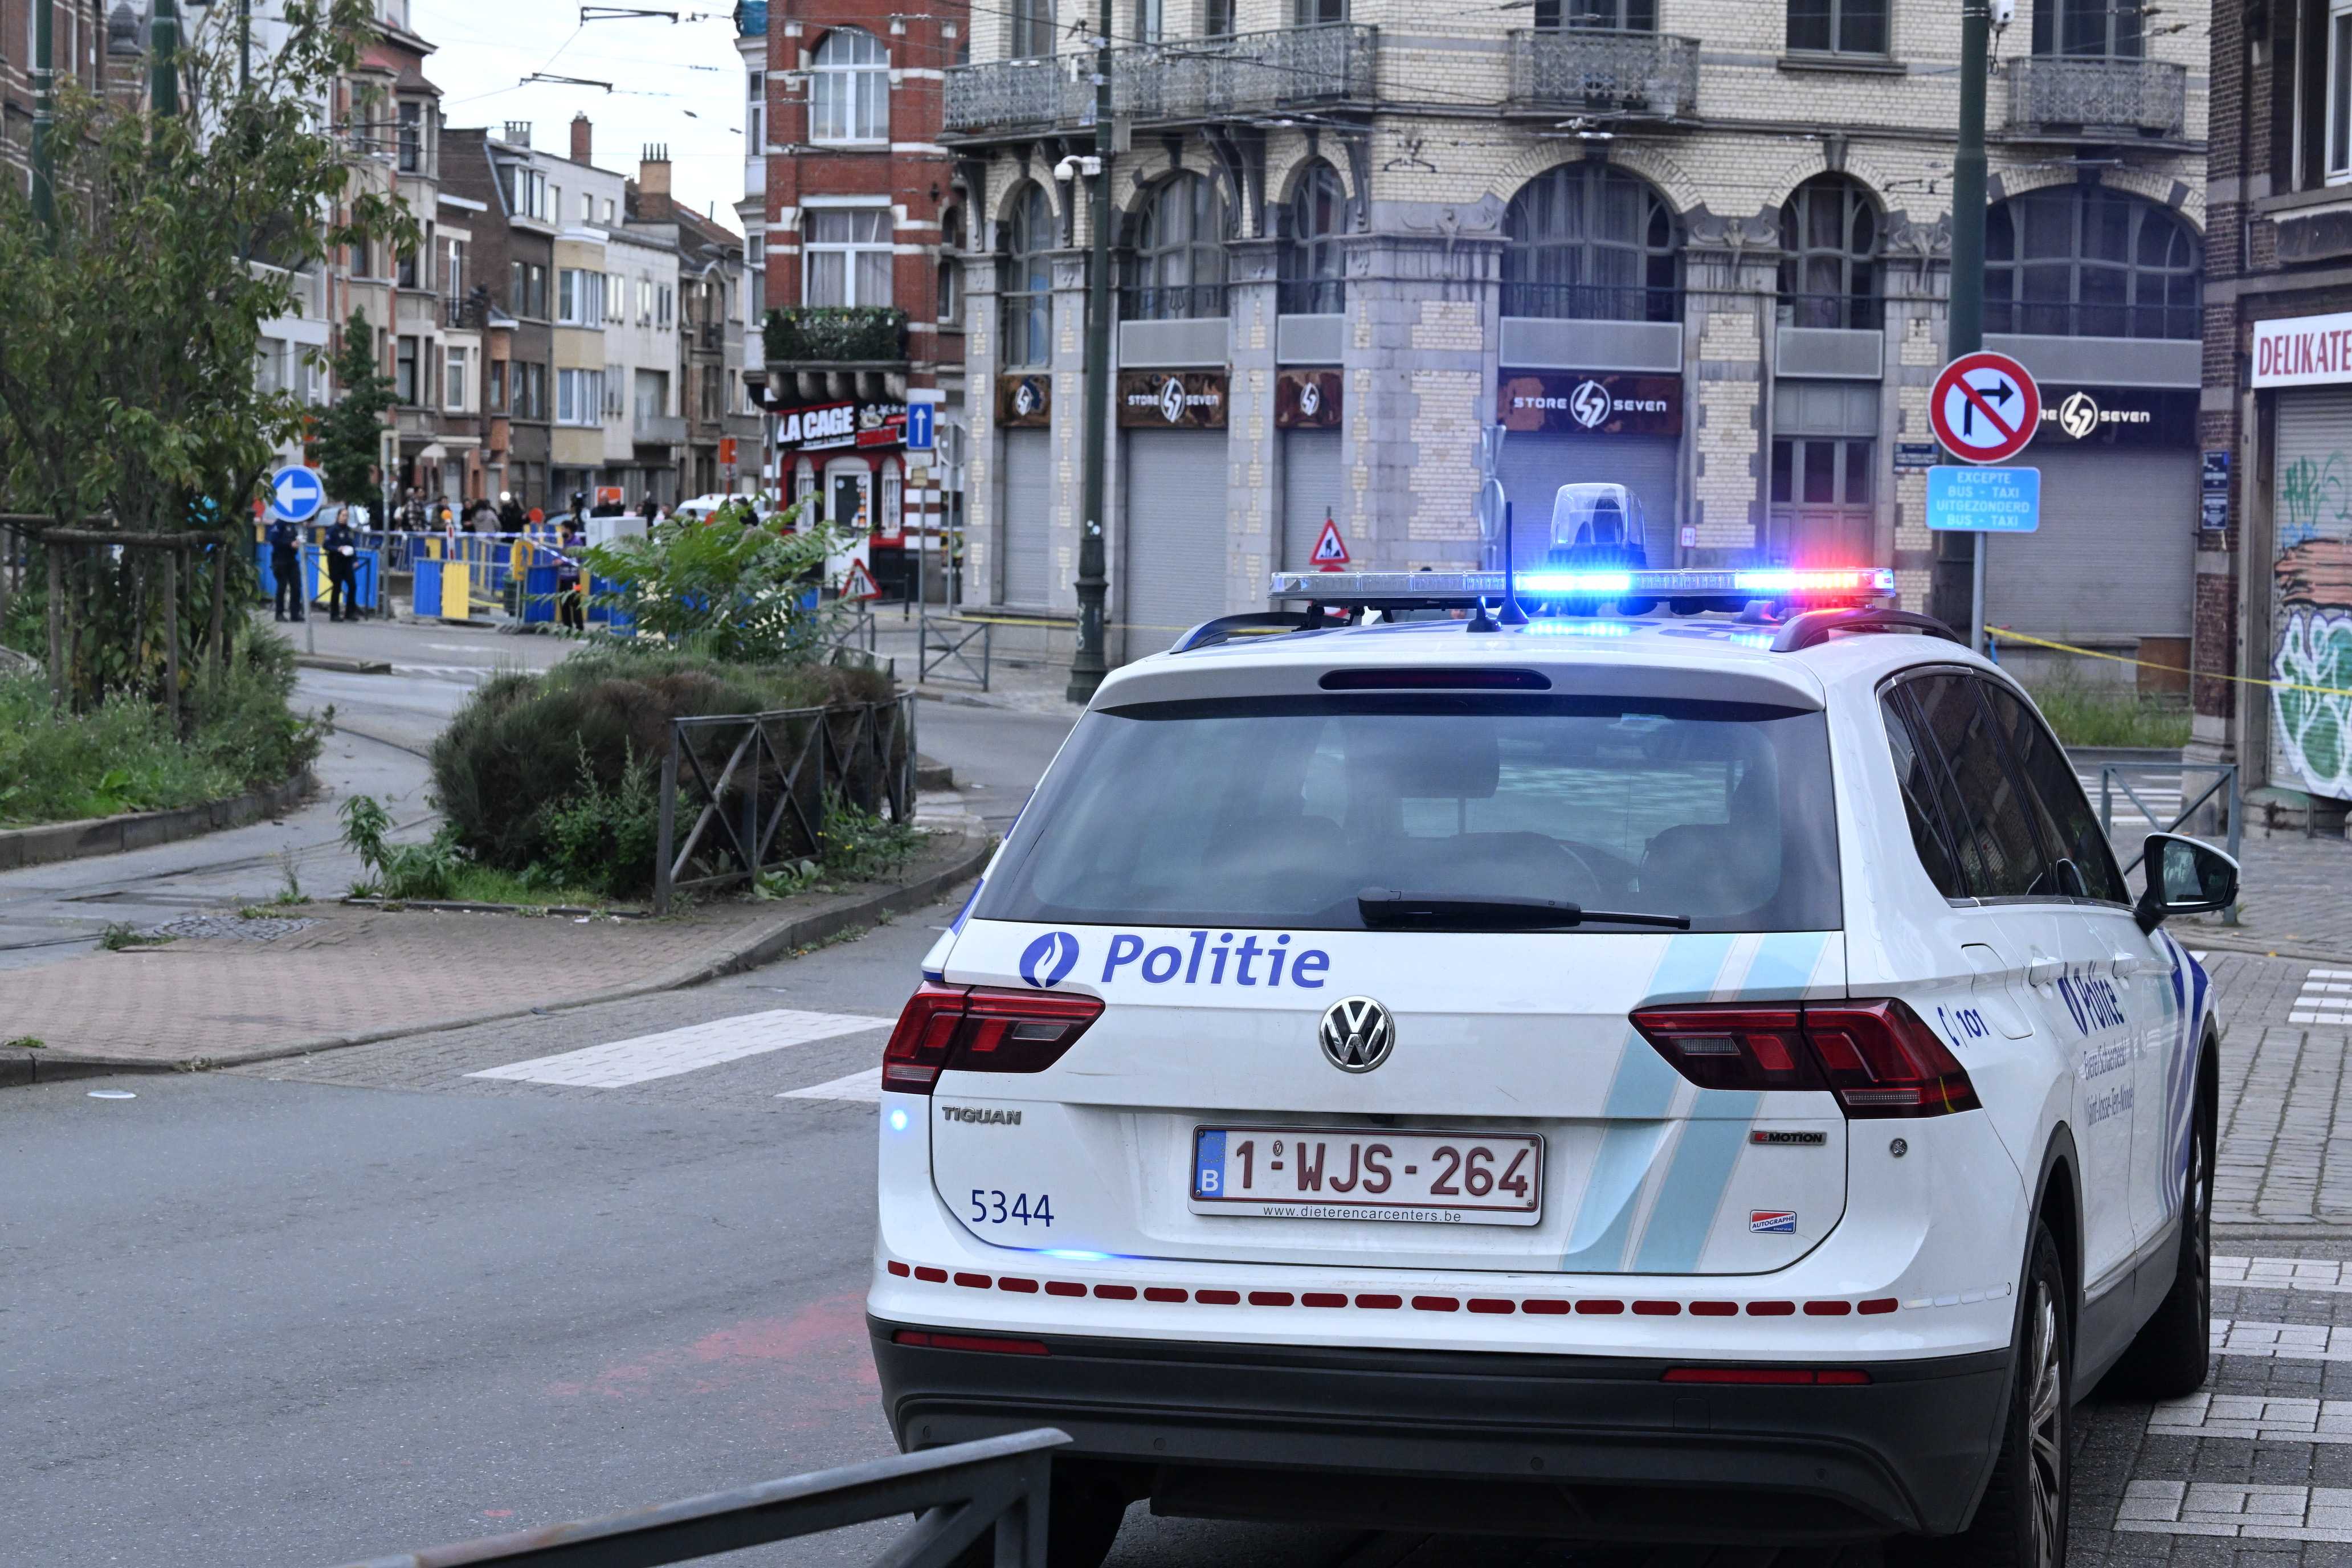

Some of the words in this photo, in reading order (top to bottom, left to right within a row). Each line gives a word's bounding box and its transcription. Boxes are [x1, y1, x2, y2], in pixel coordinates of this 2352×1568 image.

[1128, 394, 1159, 406] STORE
[1186, 394, 1218, 406] SEVEN
[1514, 397, 1567, 409] STORE
[1614, 399, 1667, 412] SEVEN
[777, 414, 801, 443] LA
[803, 406, 854, 440] CAGE
[2100, 410, 2150, 423] SEVEN
[1957, 471, 2011, 484] EXCEPTE
[1947, 486, 1973, 497] BUS
[1992, 487, 2019, 498] TAXI
[1937, 500, 2030, 513] UITGEZONDERD
[1946, 515, 1973, 526] BUS
[1991, 515, 2018, 526] TAXI
[1101, 931, 1330, 989] Politie
[2074, 961, 2124, 1030] Police
[1956, 1008, 1990, 1038] 101
[942, 1105, 1022, 1125] TIGUAN
[1202, 1170, 1218, 1191] B
[972, 1190, 1054, 1227] 5344
[1263, 1205, 1461, 1222] www.dieterencarcenters.be
[1752, 1215, 1795, 1228] AUTOGRAPHE
